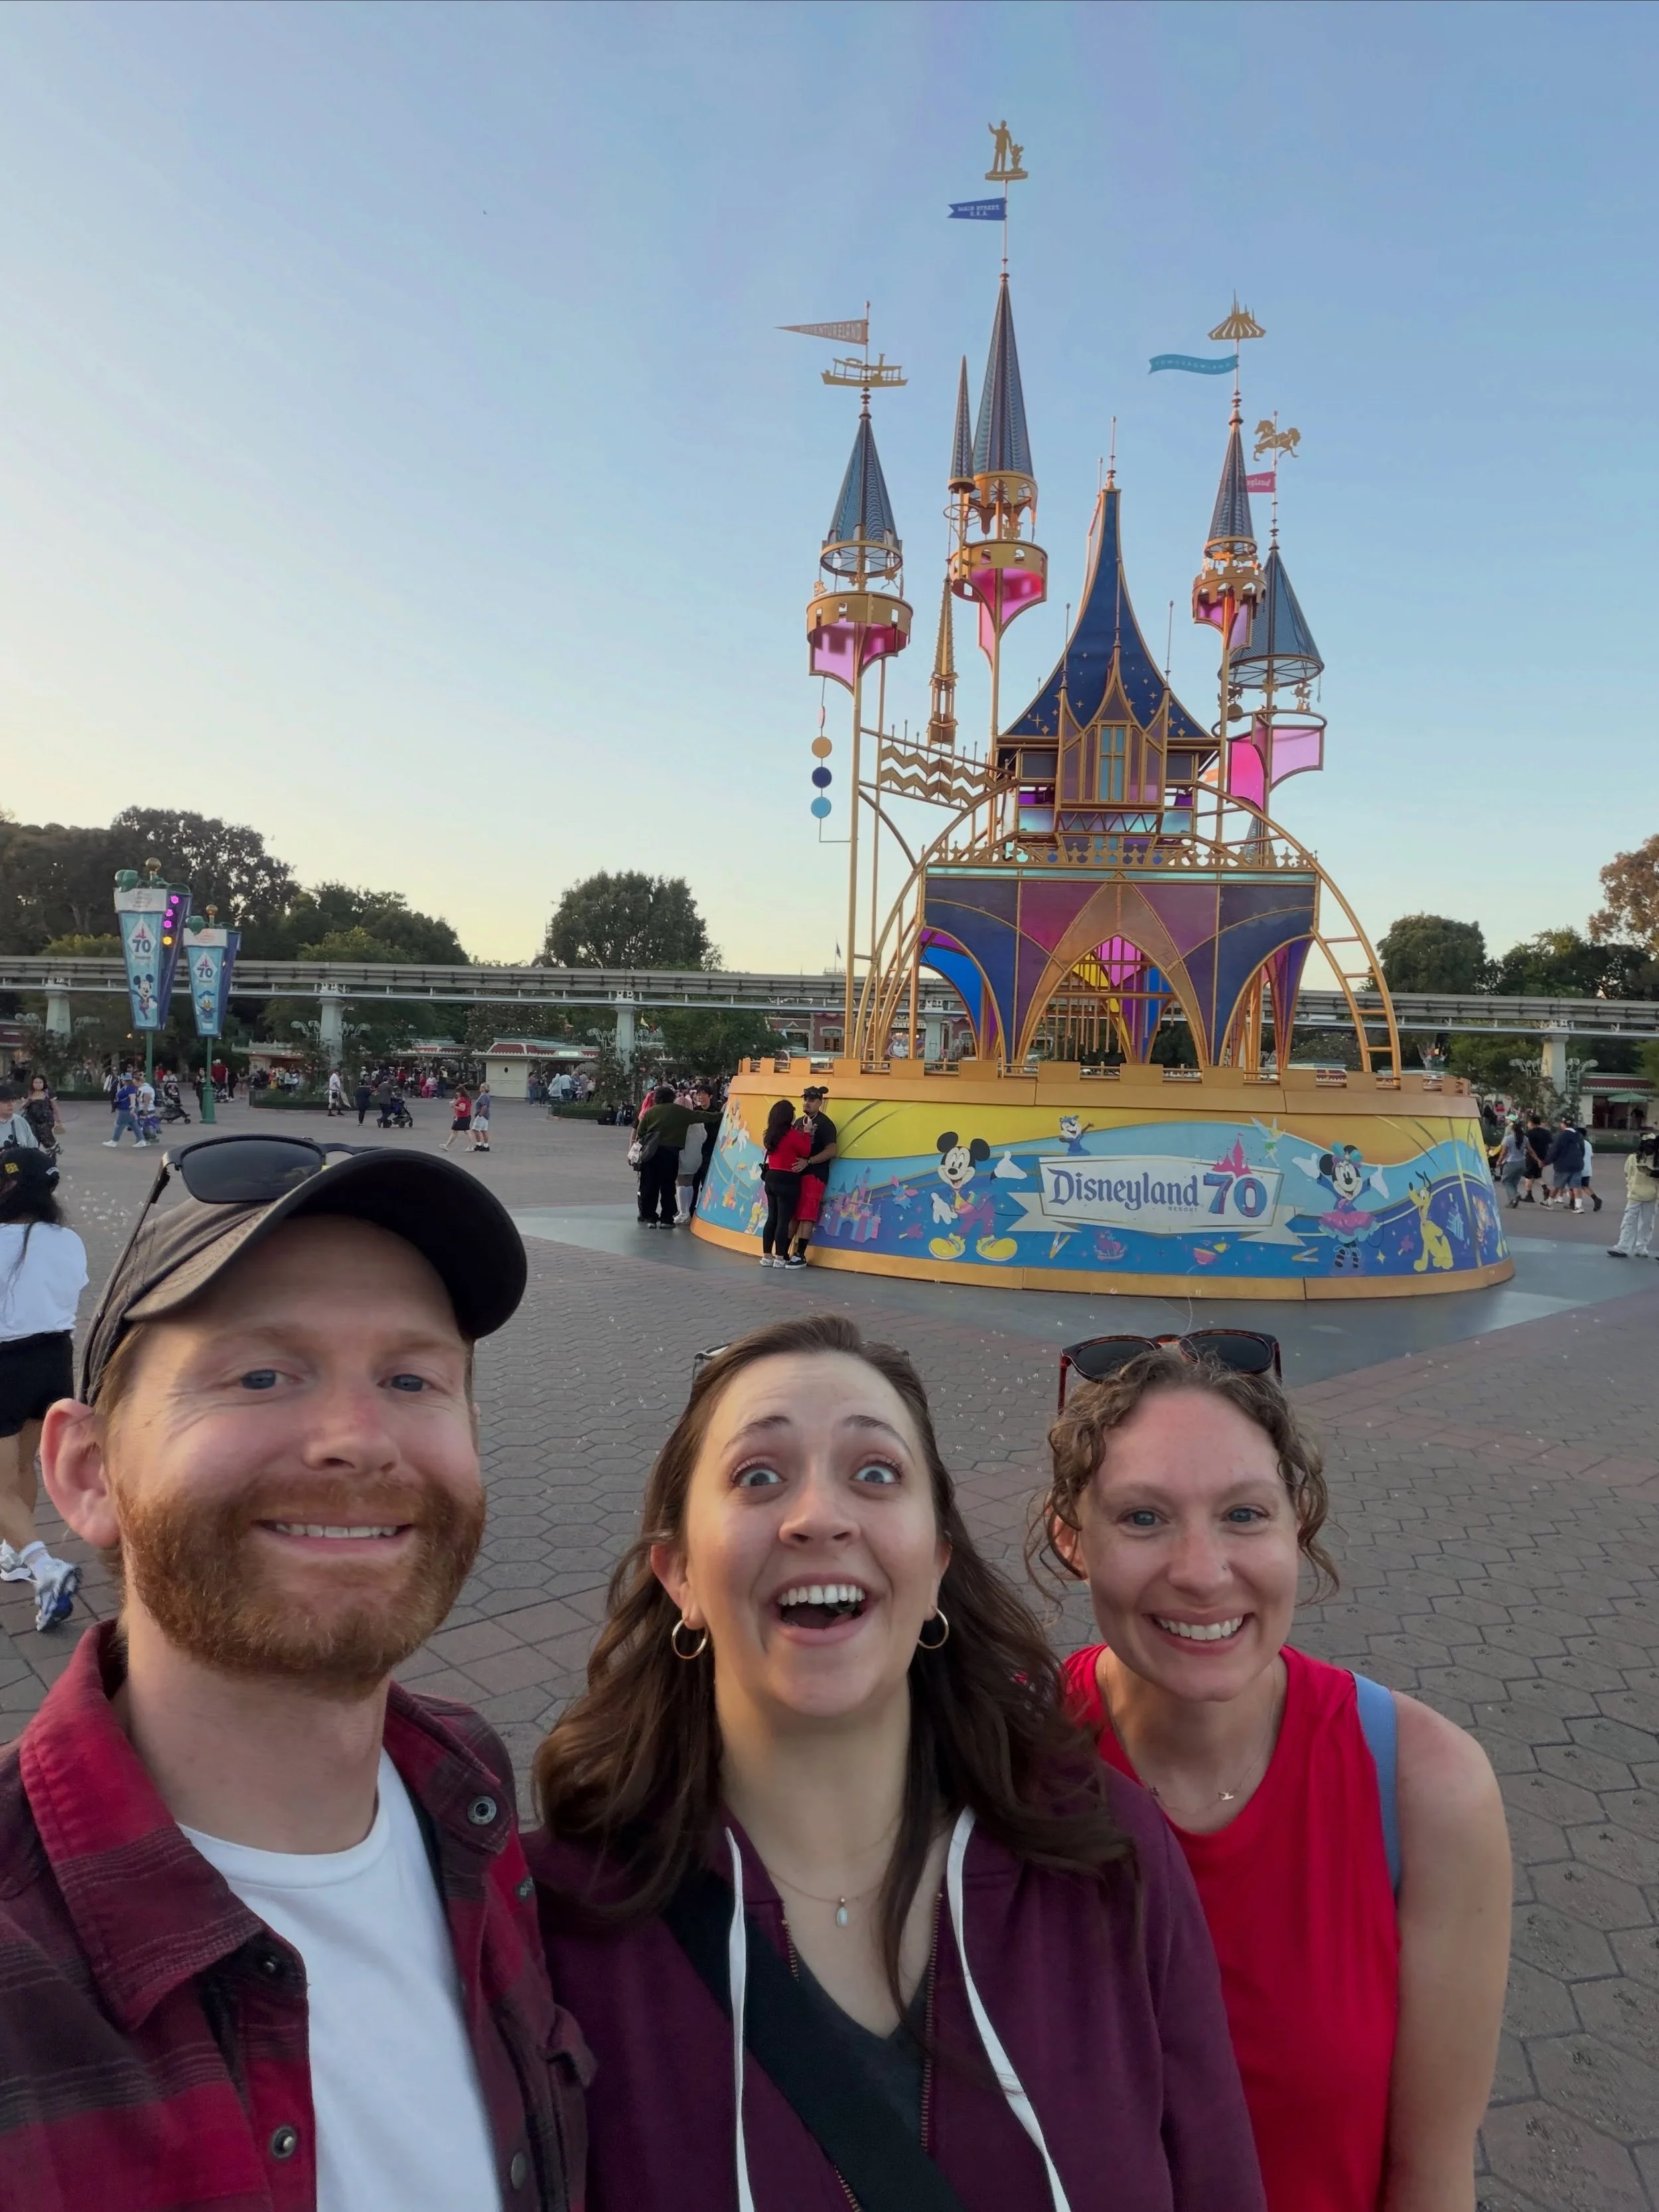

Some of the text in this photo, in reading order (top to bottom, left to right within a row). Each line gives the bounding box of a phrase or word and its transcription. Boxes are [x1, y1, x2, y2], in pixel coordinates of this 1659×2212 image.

[800, 322, 862, 341] ADVENTURELAND
[132, 939, 151, 953] 70
[197, 967, 213, 978] 70
[1047, 1167, 1267, 1218] Disneyland 70
